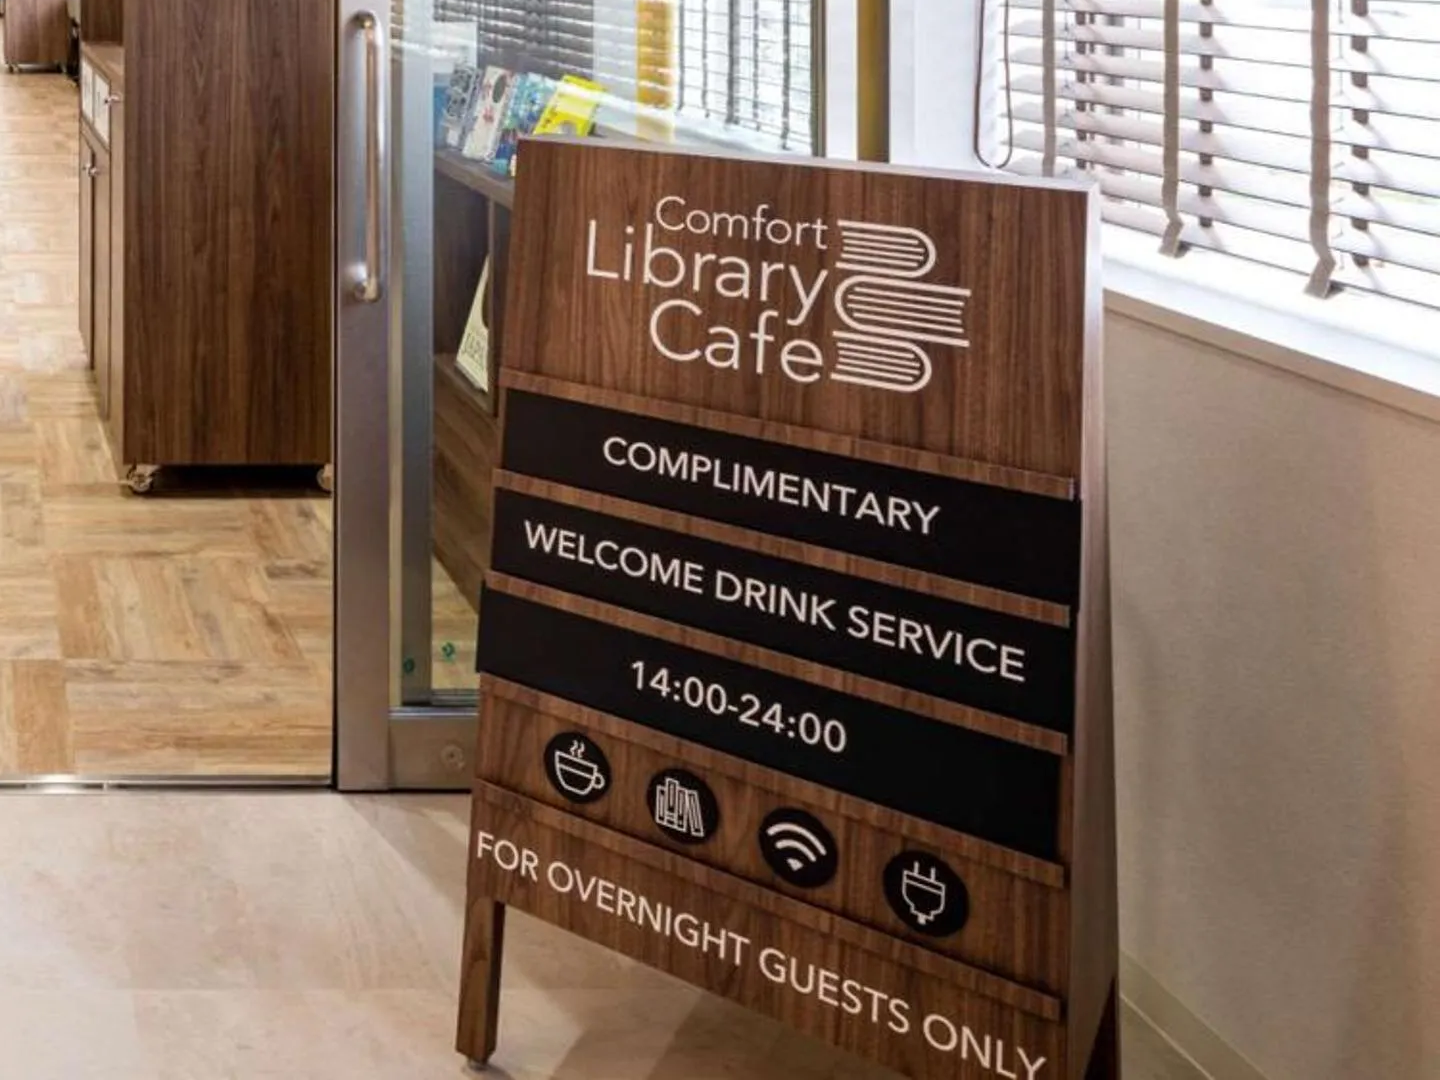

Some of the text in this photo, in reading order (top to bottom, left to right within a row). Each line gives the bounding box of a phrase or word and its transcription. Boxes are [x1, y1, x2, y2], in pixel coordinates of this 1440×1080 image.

[655, 195, 828, 250] Comfort
[586, 219, 828, 326] Library
[649, 298, 824, 383] Cafe
[602, 436, 941, 535] COMPLIMENTARY
[524, 520, 1026, 683] WELCOME DRINK SERVICE
[631, 660, 847, 754] 14:00-24:00
[476, 830, 1047, 1080] FOR OVERNIGHT GUESTS ONLY
